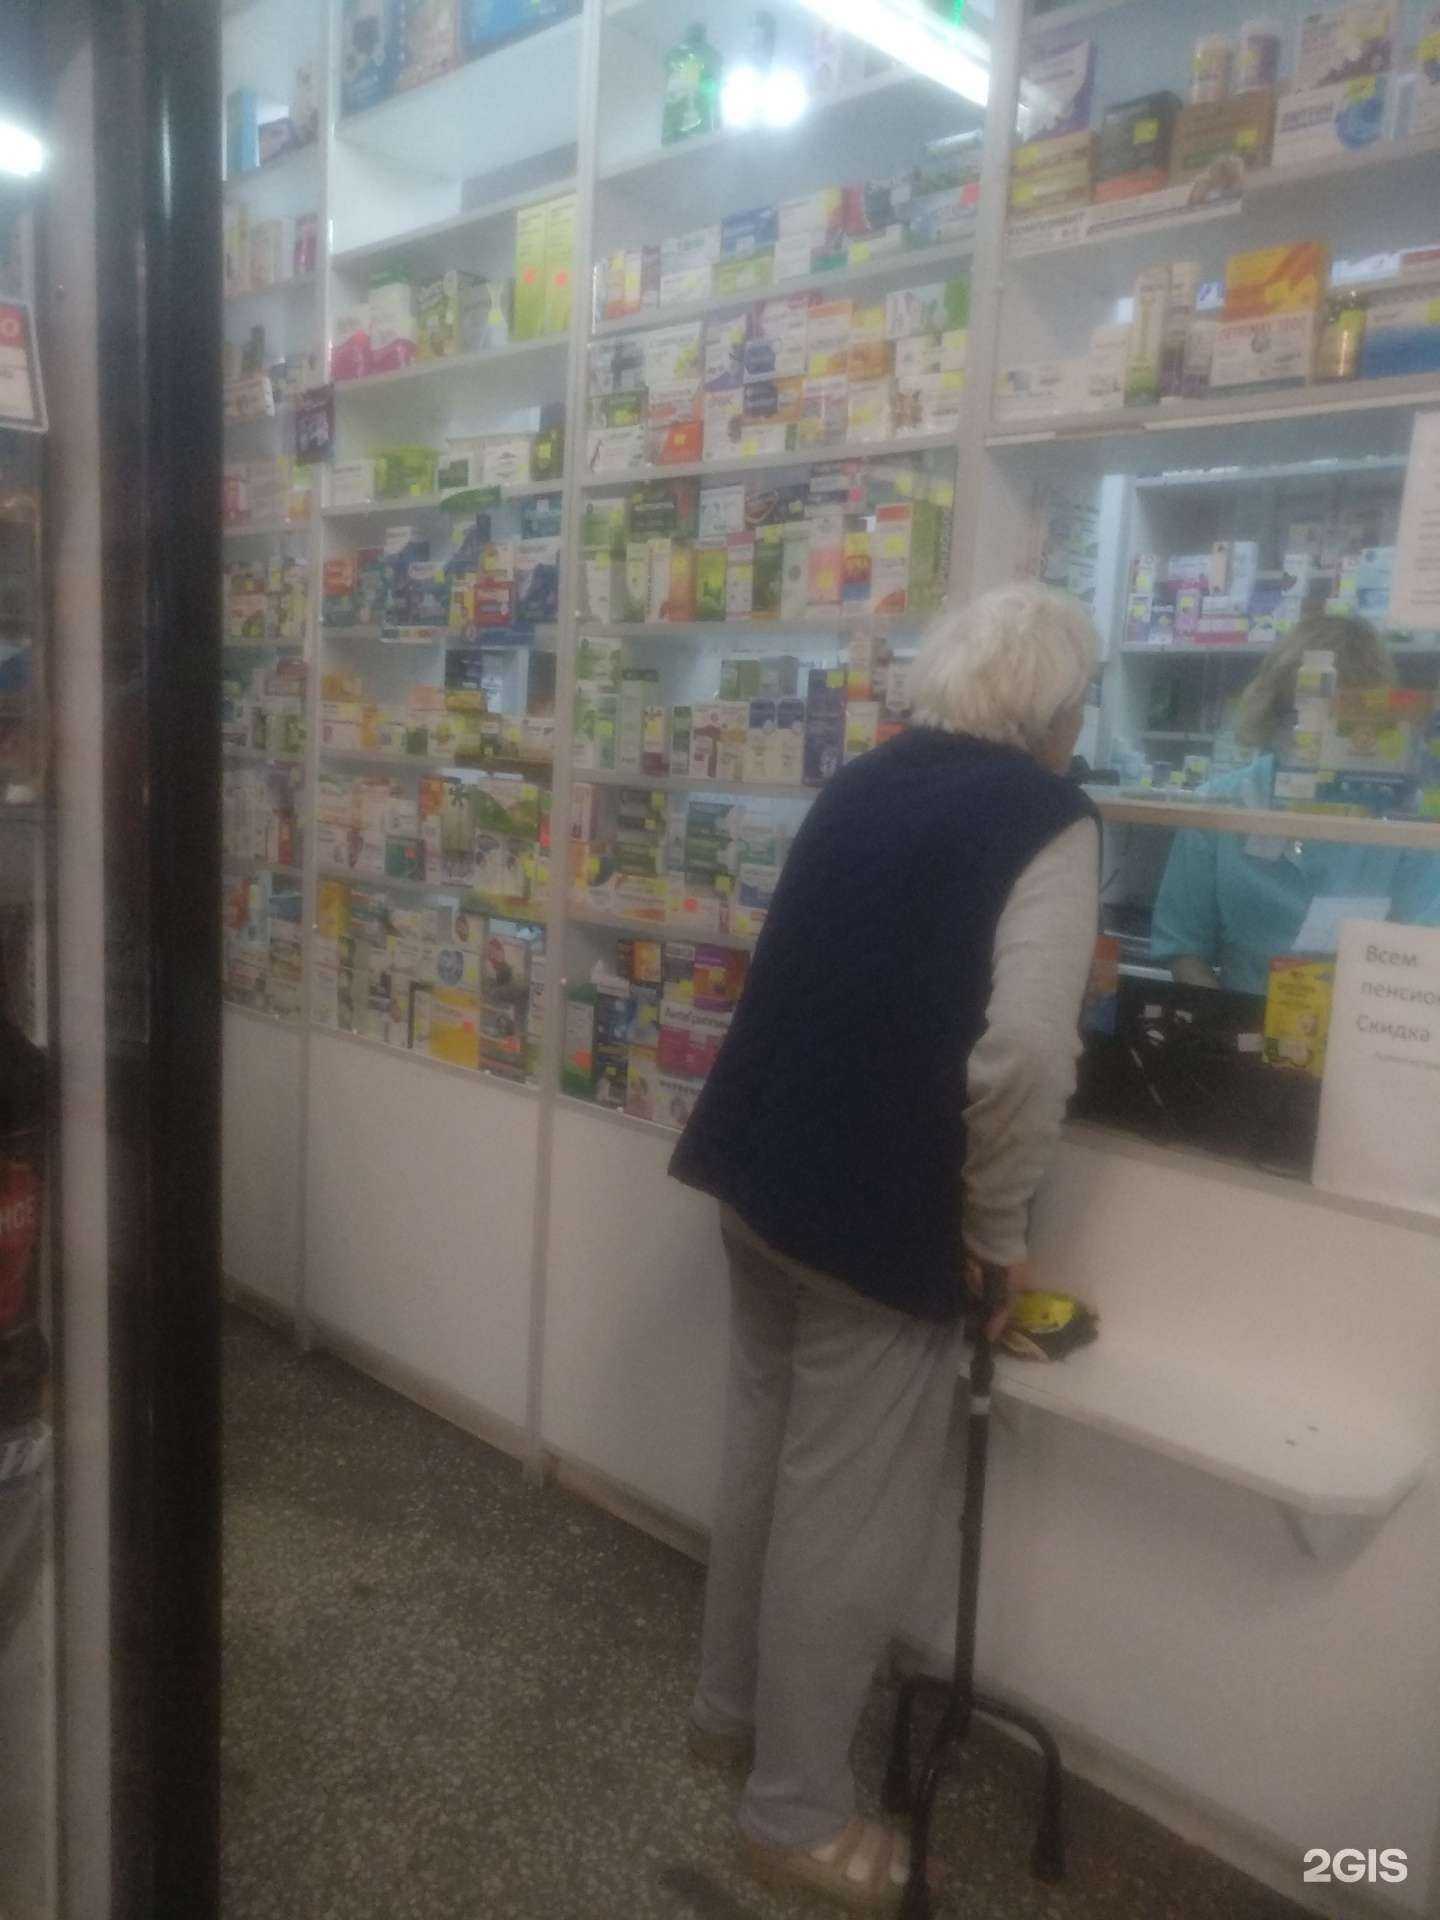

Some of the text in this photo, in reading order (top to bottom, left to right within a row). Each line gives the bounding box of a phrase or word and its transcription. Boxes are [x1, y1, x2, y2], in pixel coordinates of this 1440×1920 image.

[1366, 944, 1417, 967] Всем
[1361, 982, 1440, 1006] пенсио
[1356, 1014, 1430, 1042] Скидка
